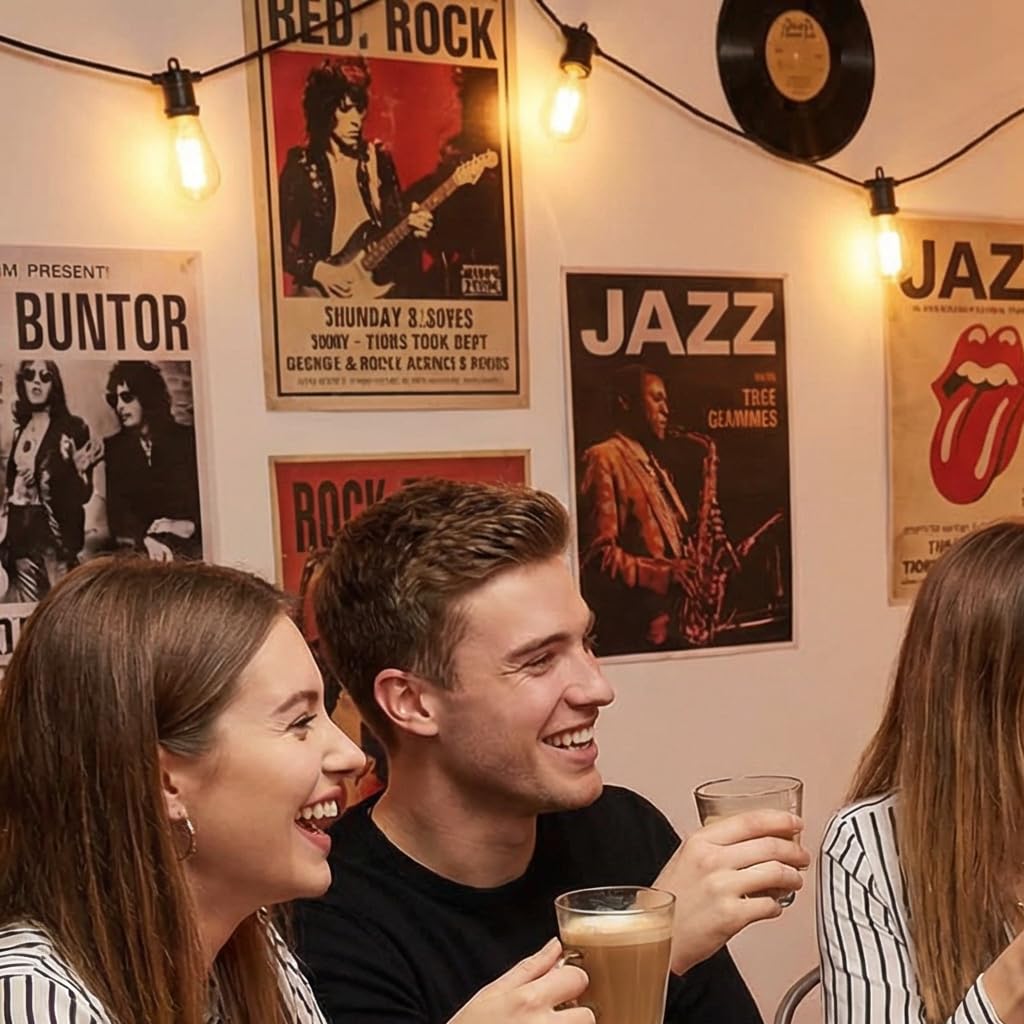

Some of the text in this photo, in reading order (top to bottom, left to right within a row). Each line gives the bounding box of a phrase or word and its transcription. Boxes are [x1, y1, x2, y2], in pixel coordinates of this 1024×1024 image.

[385, 0, 498, 61] ROCK
[0, 264, 18, 277] M
[15, 291, 190, 351] BUNTOR
[325, 306, 401, 328] SHUNDAY
[580, 288, 777, 356] JAZZ
[411, 333, 449, 351] TOOK
[345, 356, 358, 371] &
[742, 388, 776, 407] TREE
